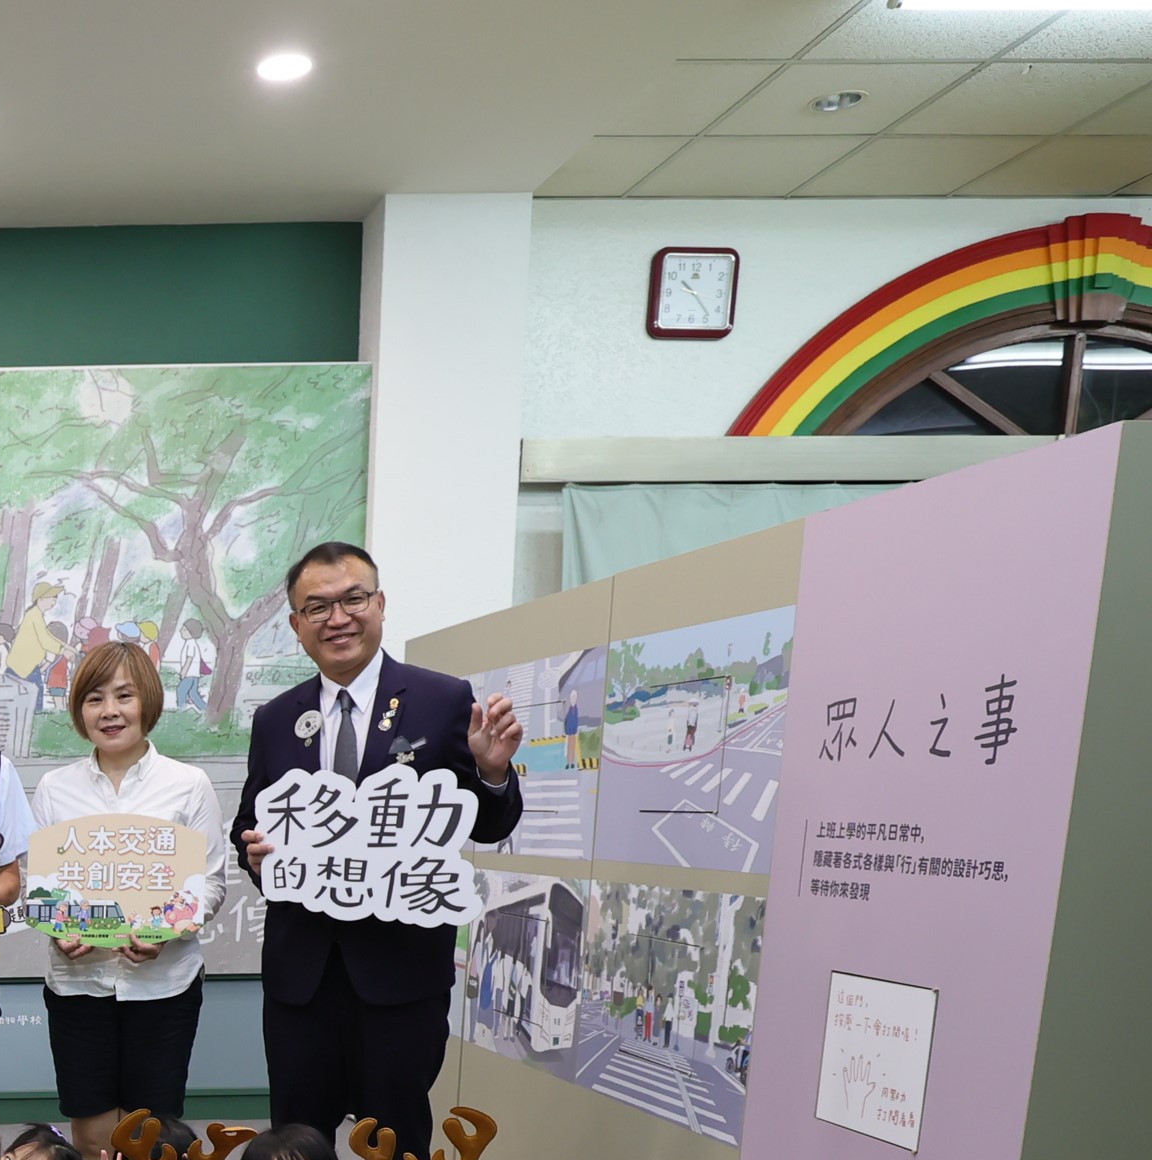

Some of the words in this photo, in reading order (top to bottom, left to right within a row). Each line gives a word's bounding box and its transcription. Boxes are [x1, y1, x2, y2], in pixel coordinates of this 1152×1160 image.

[679, 263, 686, 271] 11
[692, 263, 702, 272] 12
[708, 263, 713, 272] 1
[668, 271, 678, 280] 10
[718, 272, 725, 281] 2
[666, 288, 672, 297] 9
[716, 289, 723, 298] 3
[664, 304, 670, 313] 8
[714, 305, 721, 313] 4
[676, 314, 682, 323] 7
[688, 314, 695, 323] 6
[702, 314, 709, 323] 5
[819, 673, 1018, 765] 眾人之事
[267, 778, 463, 848] 移動力
[816, 821, 925, 843] 上班上學的平凡日常中，
[62, 825, 177, 856] 人本交通
[57, 861, 176, 892] 共創安全
[273, 856, 467, 915] 的想像
[810, 878, 871, 901] 等待你來發現
